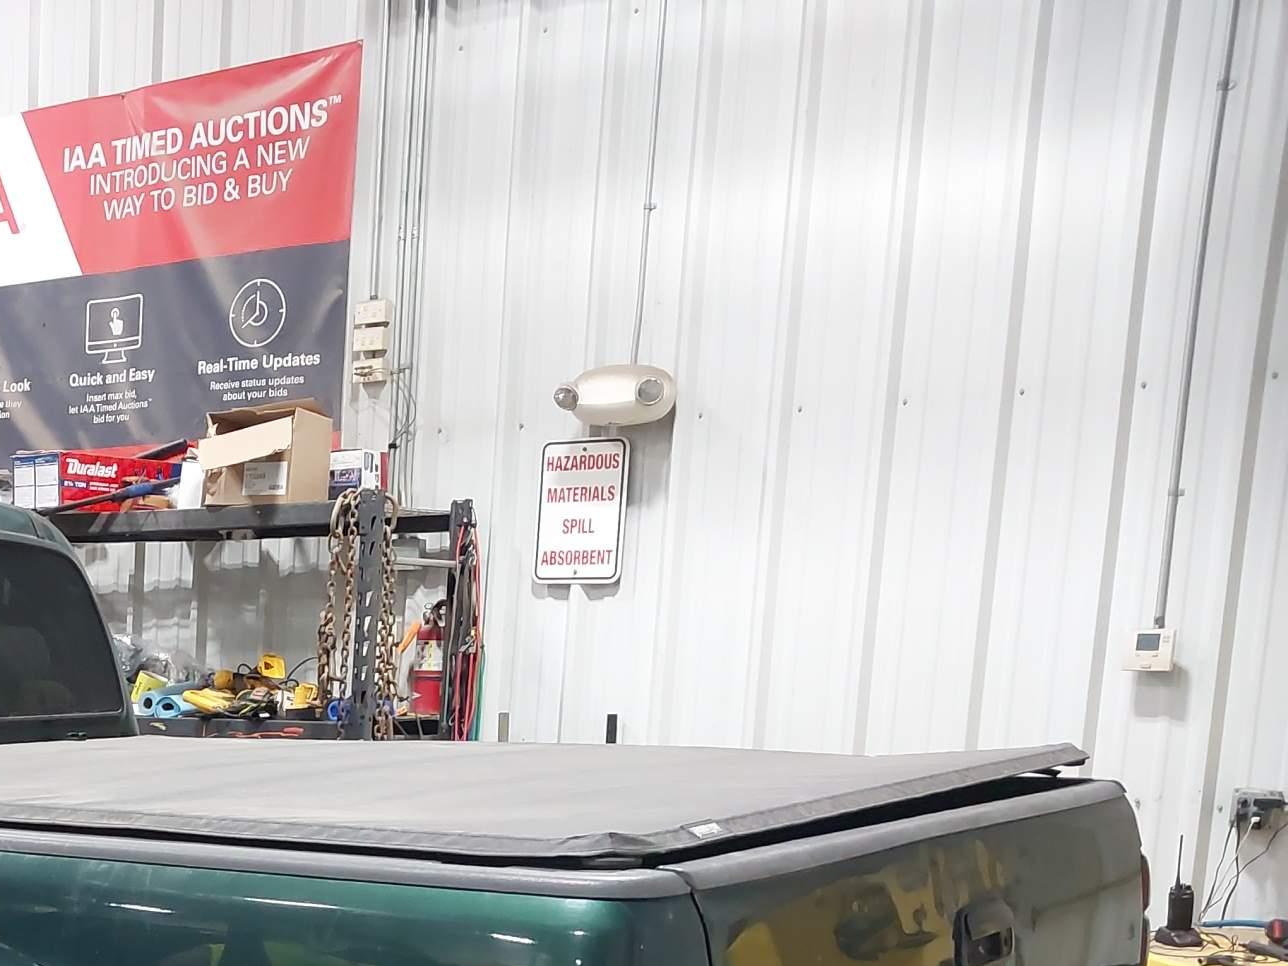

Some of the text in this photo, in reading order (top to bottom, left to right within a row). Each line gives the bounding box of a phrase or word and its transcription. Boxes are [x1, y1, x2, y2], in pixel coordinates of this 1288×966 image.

[63, 143, 106, 173] IAA
[112, 127, 183, 165] TIMED
[90, 135, 311, 196] INTRODUCING A NEW
[103, 168, 293, 221] WAY TO BID & BUY
[198, 353, 321, 375] Real-Time Updates
[2, 378, 31, 393] Look
[69, 367, 155, 387] Quick and Easy
[210, 375, 305, 390] Receive status updates
[86, 392, 106, 402] Insert
[107, 391, 123, 401] max
[222, 388, 288, 401] about your bids
[80, 404, 95, 413] IAA
[96, 403, 117, 413] Timed
[93, 414, 130, 424] bid for you
[66, 457, 119, 479] Duralast
[546, 453, 620, 472] HAZARDOUS
[547, 485, 616, 503] MATERIALS
[562, 518, 595, 535] SPILL
[541, 549, 613, 566] ABSORBENT
